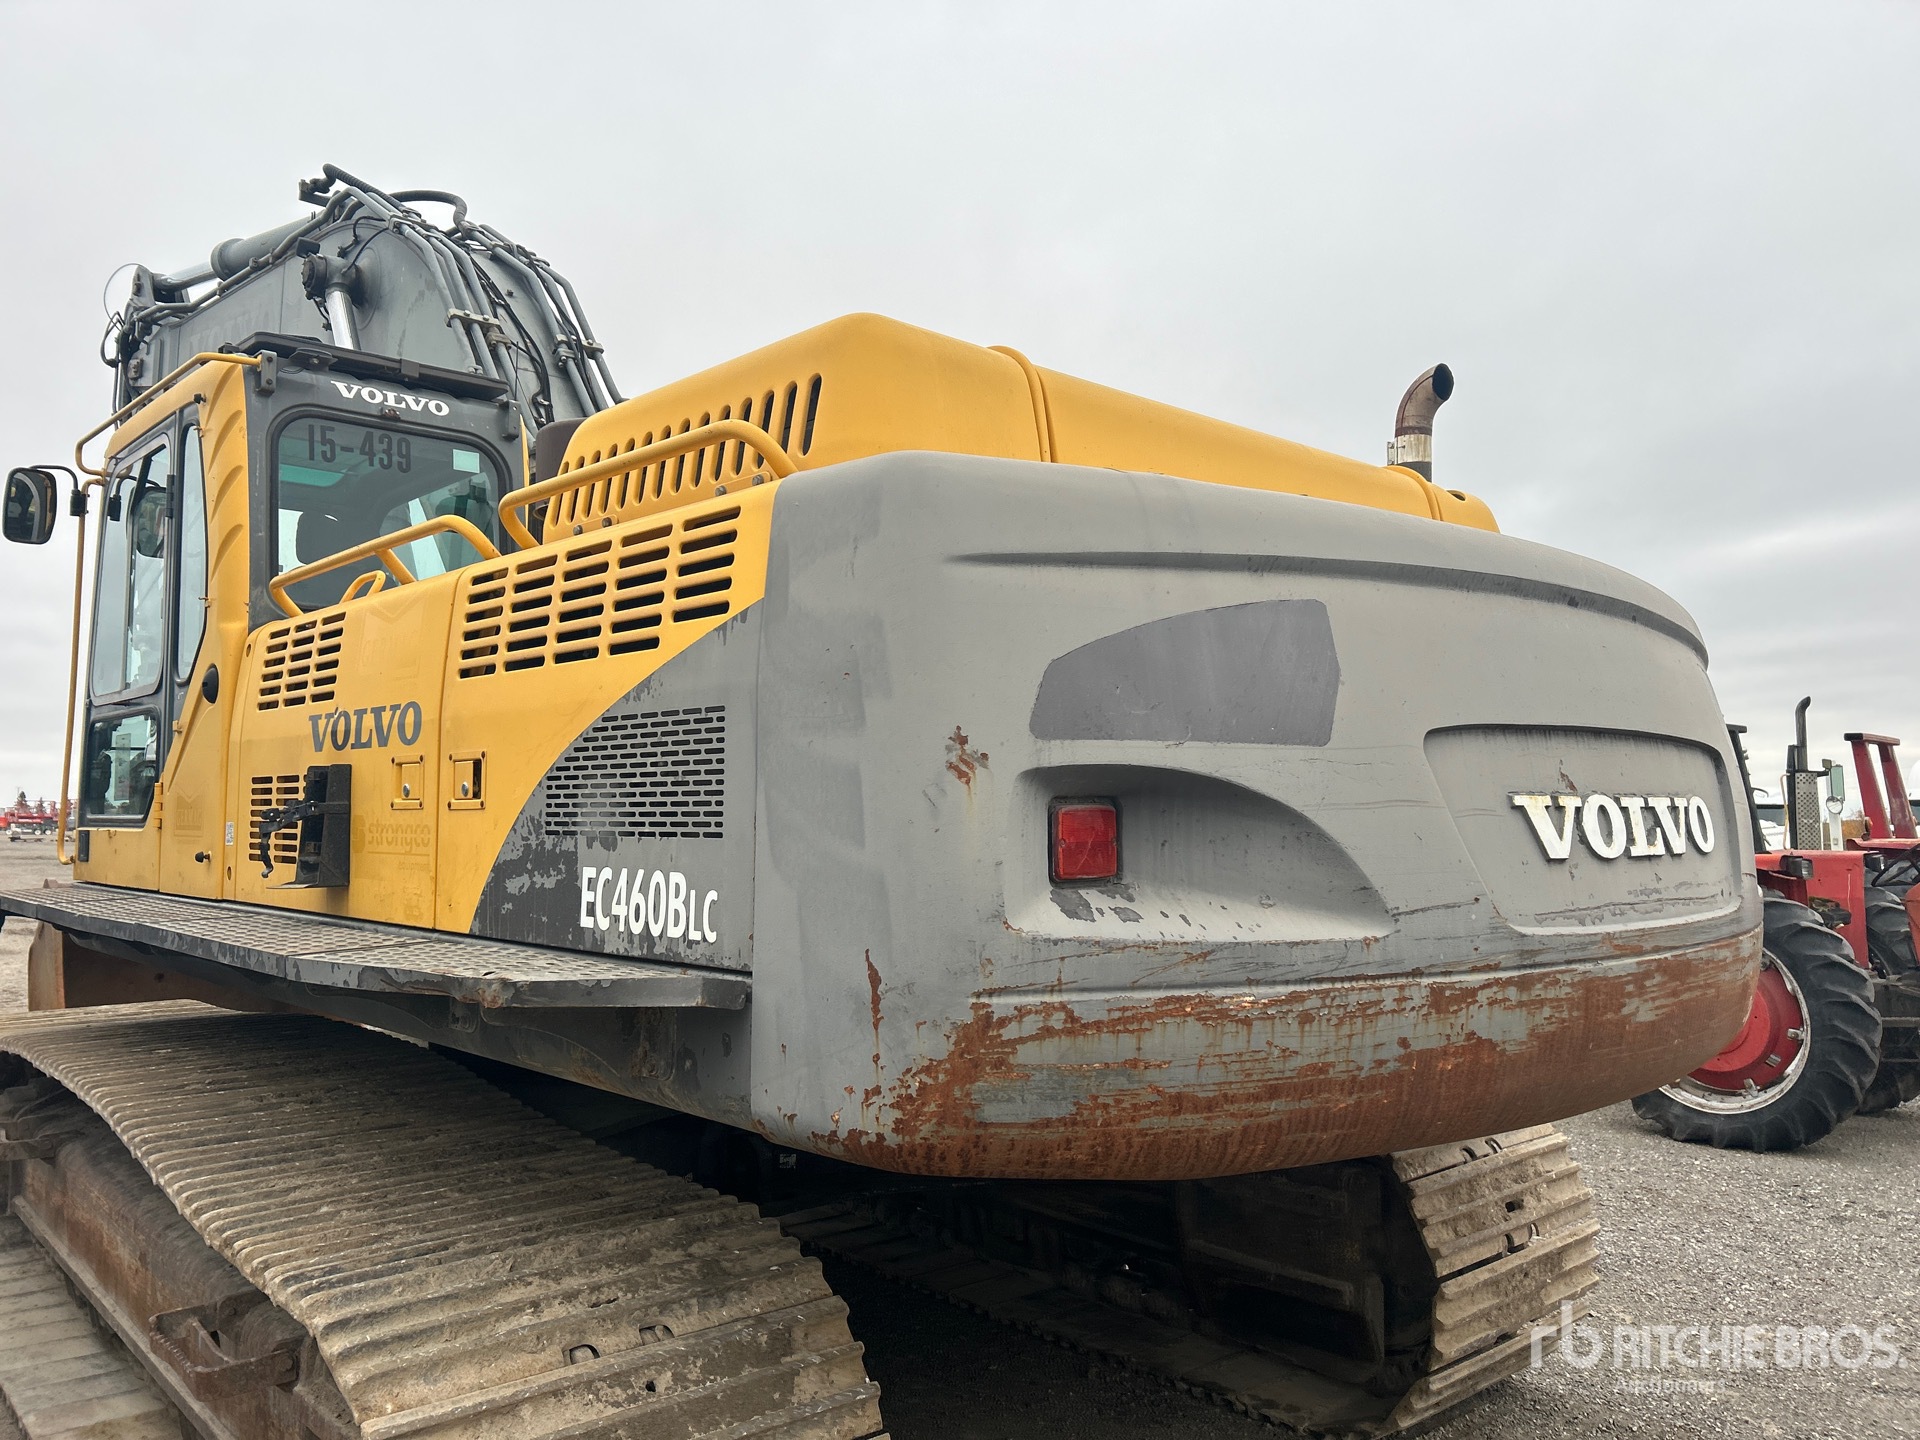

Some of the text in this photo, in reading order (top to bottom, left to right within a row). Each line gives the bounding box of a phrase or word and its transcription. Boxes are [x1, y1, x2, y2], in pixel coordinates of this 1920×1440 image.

[331, 380, 450, 416] VOLVO
[308, 424, 411, 473] 15-439
[308, 701, 422, 752] VOLVO
[1511, 792, 1715, 860] VOLVO
